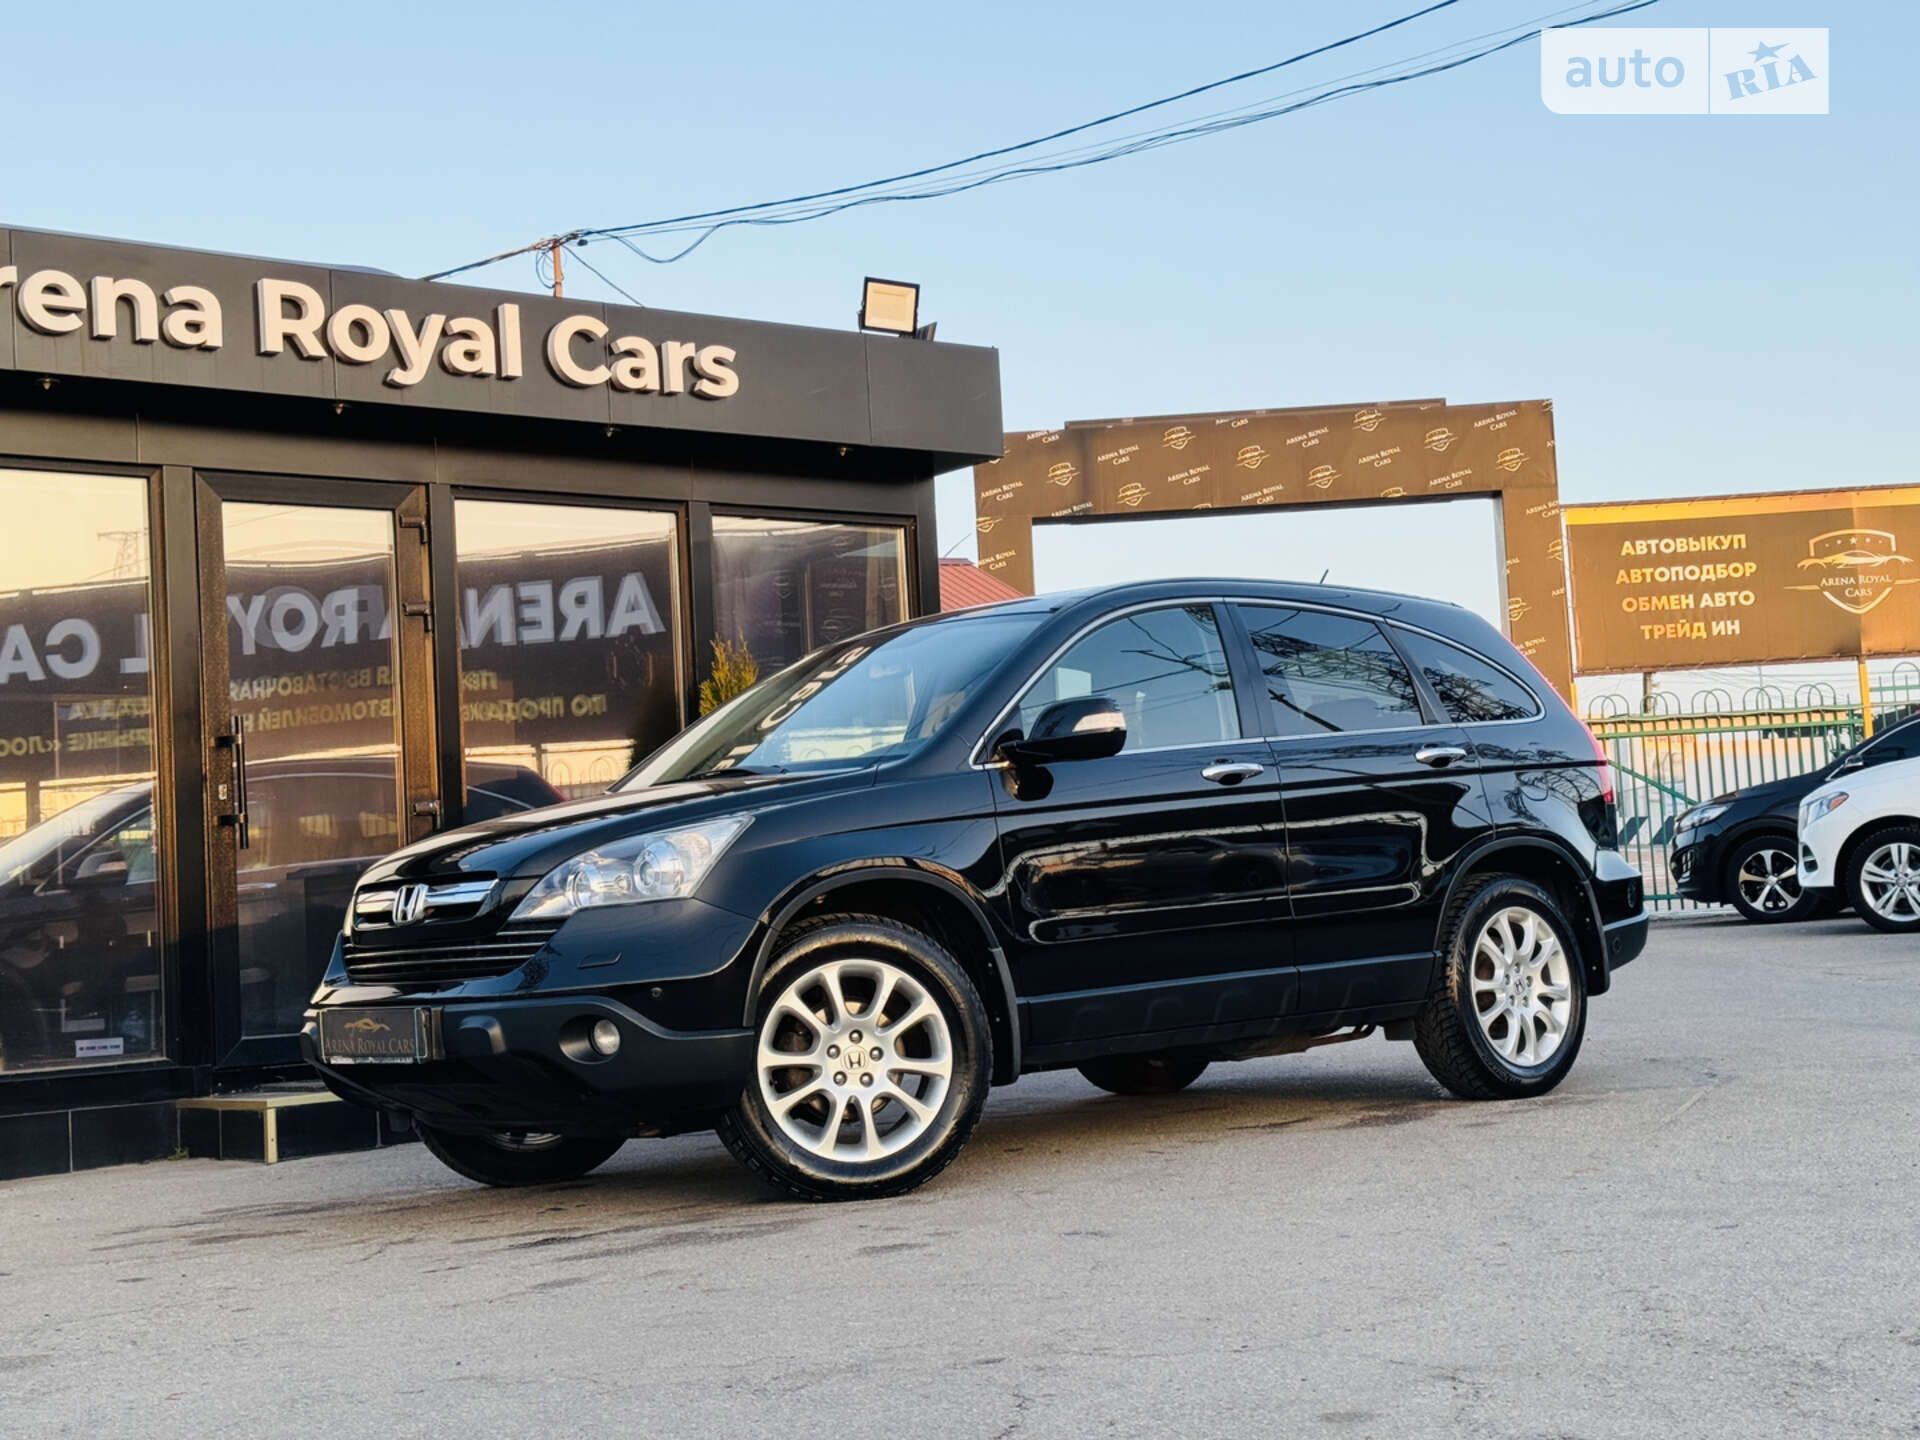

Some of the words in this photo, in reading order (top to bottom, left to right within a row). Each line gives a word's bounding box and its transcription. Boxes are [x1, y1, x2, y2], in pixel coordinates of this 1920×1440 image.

[257, 278, 522, 387] Royal
[547, 314, 739, 399] Cars
[1620, 533, 1747, 556] АВТОВЫКУП
[1616, 561, 1757, 585] АВТОПОДБОР
[1622, 593, 1694, 613] ОБМЕН
[1700, 590, 1755, 609] АВТО
[1640, 618, 1707, 640] ТРЕЙД
[1712, 619, 1740, 636] ИН
